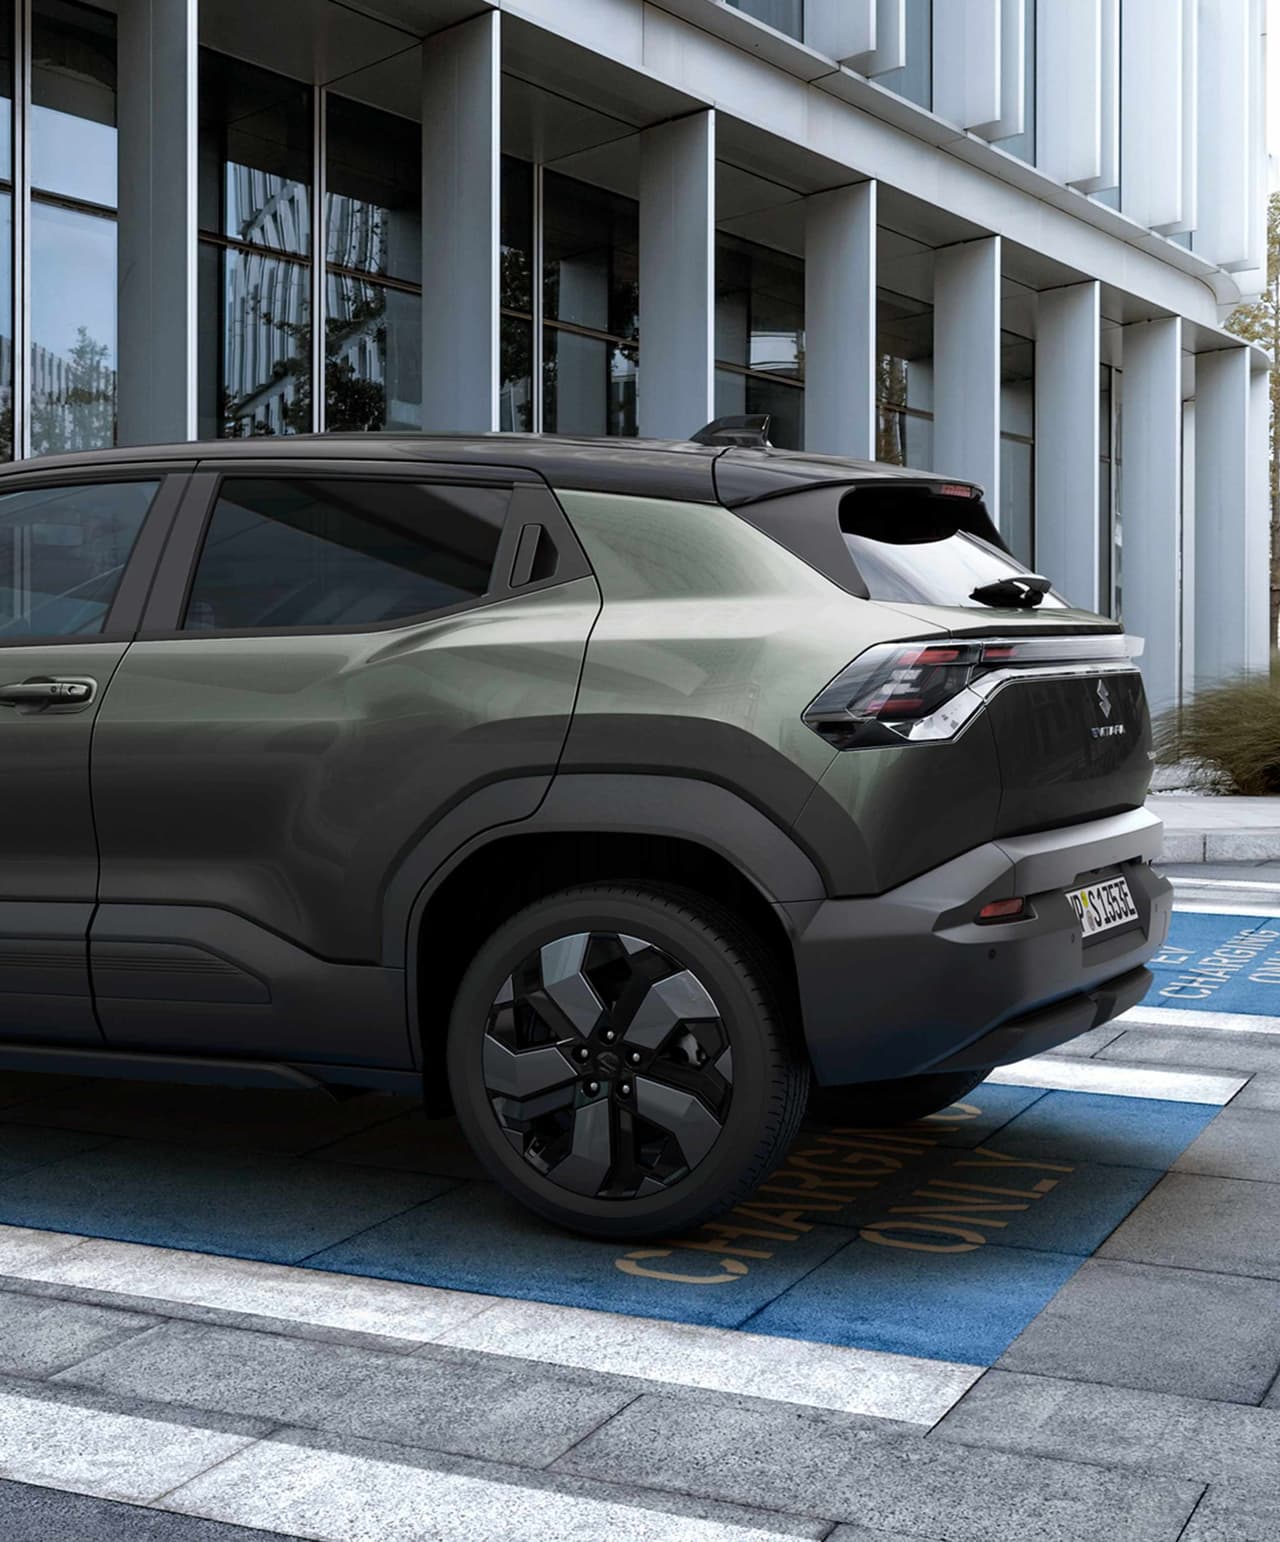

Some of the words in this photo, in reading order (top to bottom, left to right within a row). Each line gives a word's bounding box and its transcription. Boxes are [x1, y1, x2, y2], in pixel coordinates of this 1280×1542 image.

[1150, 945, 1196, 965] EV
[1158, 929, 1280, 999] CHARGING
[859, 1147, 1075, 1254] ONLY
